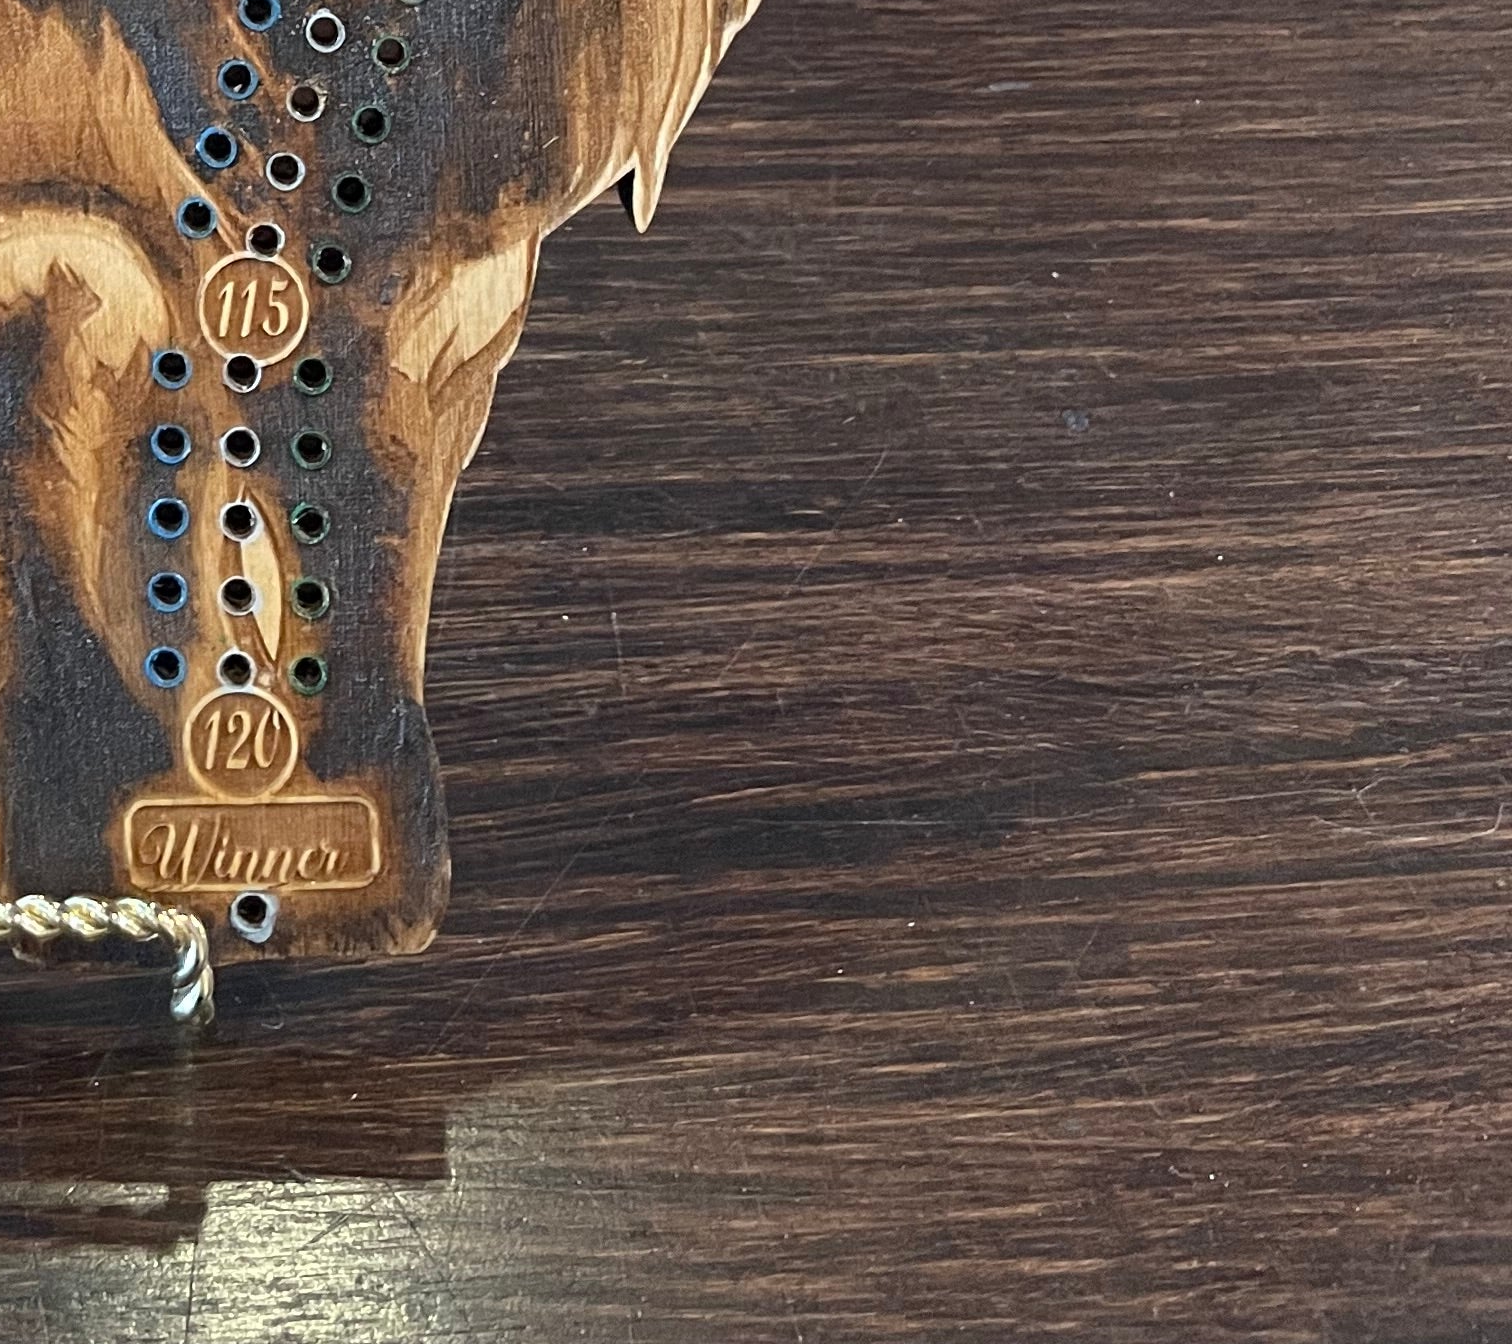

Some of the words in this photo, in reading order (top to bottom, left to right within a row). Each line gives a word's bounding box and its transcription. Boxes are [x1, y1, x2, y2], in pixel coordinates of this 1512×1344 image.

[218, 280, 289, 336] 115
[205, 710, 280, 770] 120
[140, 812, 348, 886] Winner
